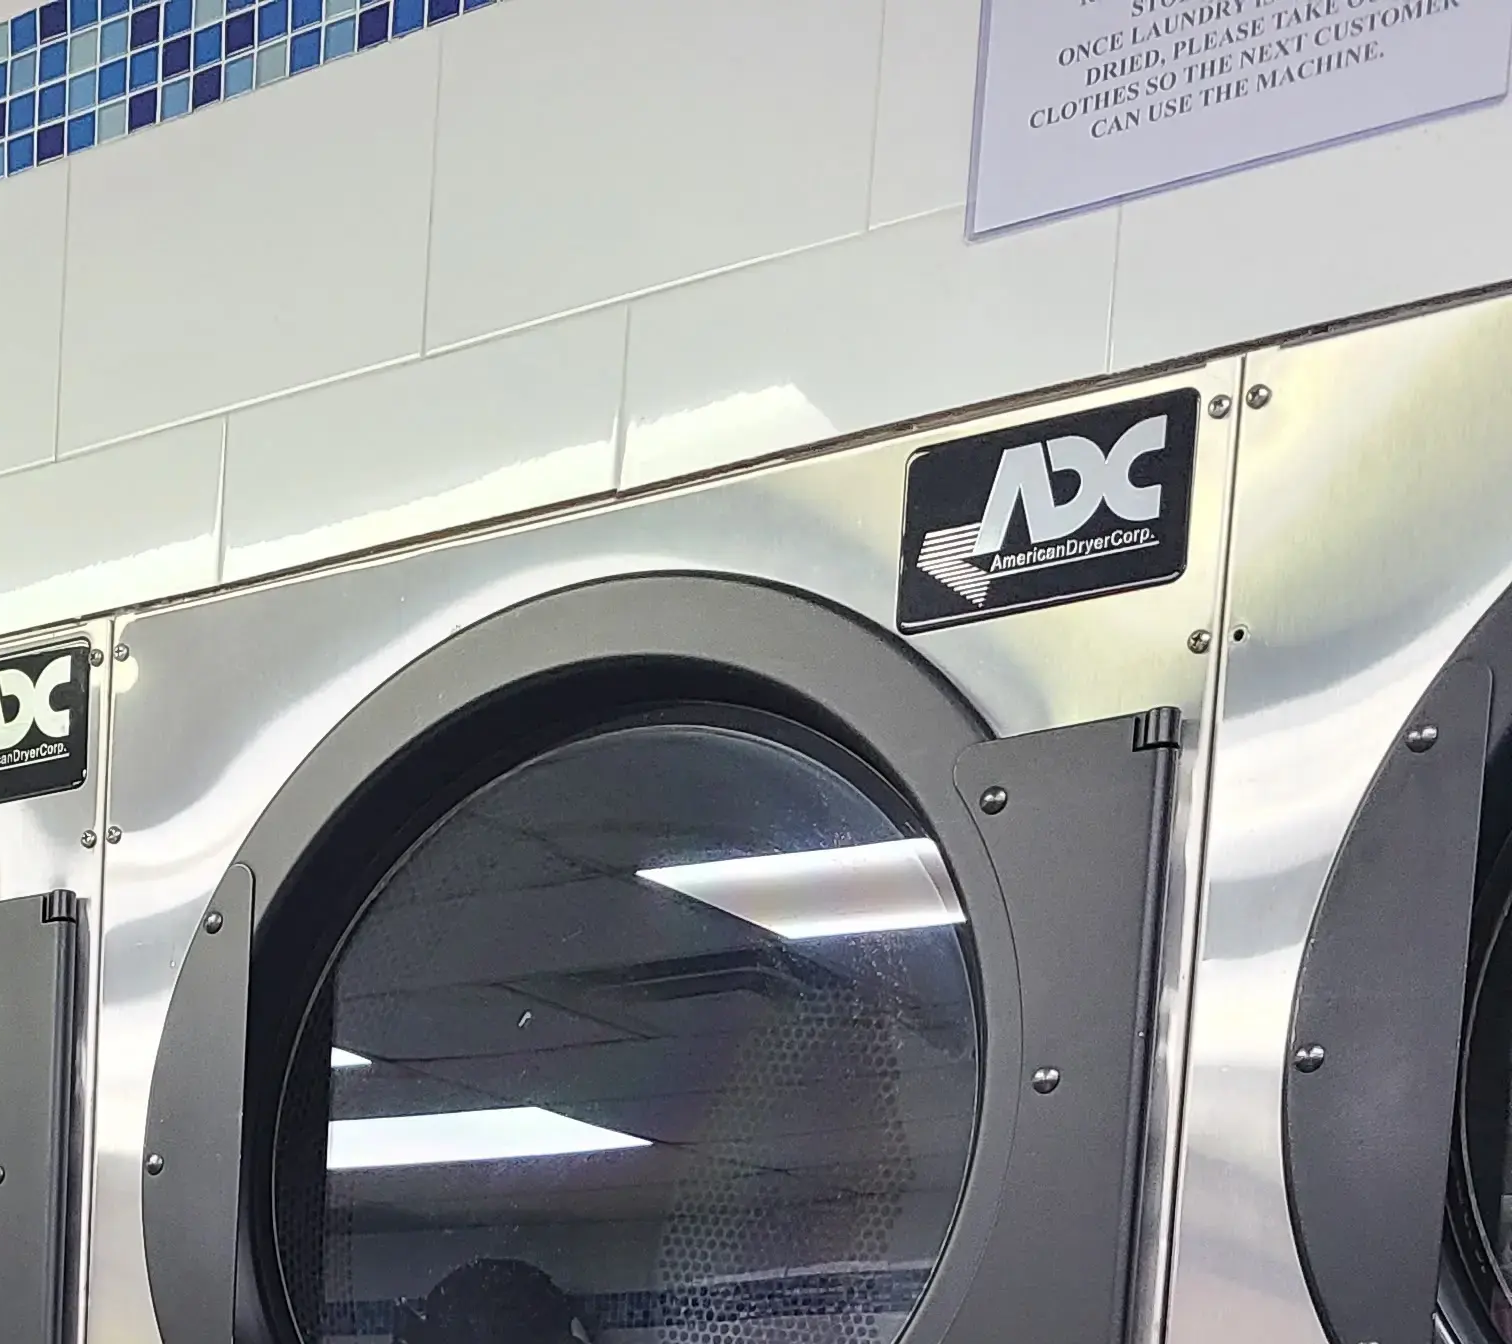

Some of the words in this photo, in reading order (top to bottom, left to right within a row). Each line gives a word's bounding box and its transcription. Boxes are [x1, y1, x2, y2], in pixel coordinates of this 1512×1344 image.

[1029, 82, 1139, 129] CLOTHES
[1145, 71, 1177, 96] SO
[1183, 53, 1232, 84] THE
[1239, 33, 1308, 69] NEXT
[1058, 31, 1123, 67] ONCE
[1131, 0, 1245, 45] LAUNDRY
[1085, 49, 1166, 87] DRIED,
[1173, 16, 1265, 60] PLEASE
[1271, 0, 1339, 30] TAKE
[1090, 108, 1140, 138] CAN
[1148, 93, 1193, 122] USE
[1199, 77, 1249, 107] THE
[1256, 40, 1385, 92] MACHINE.
[972, 414, 1168, 554] ADC
